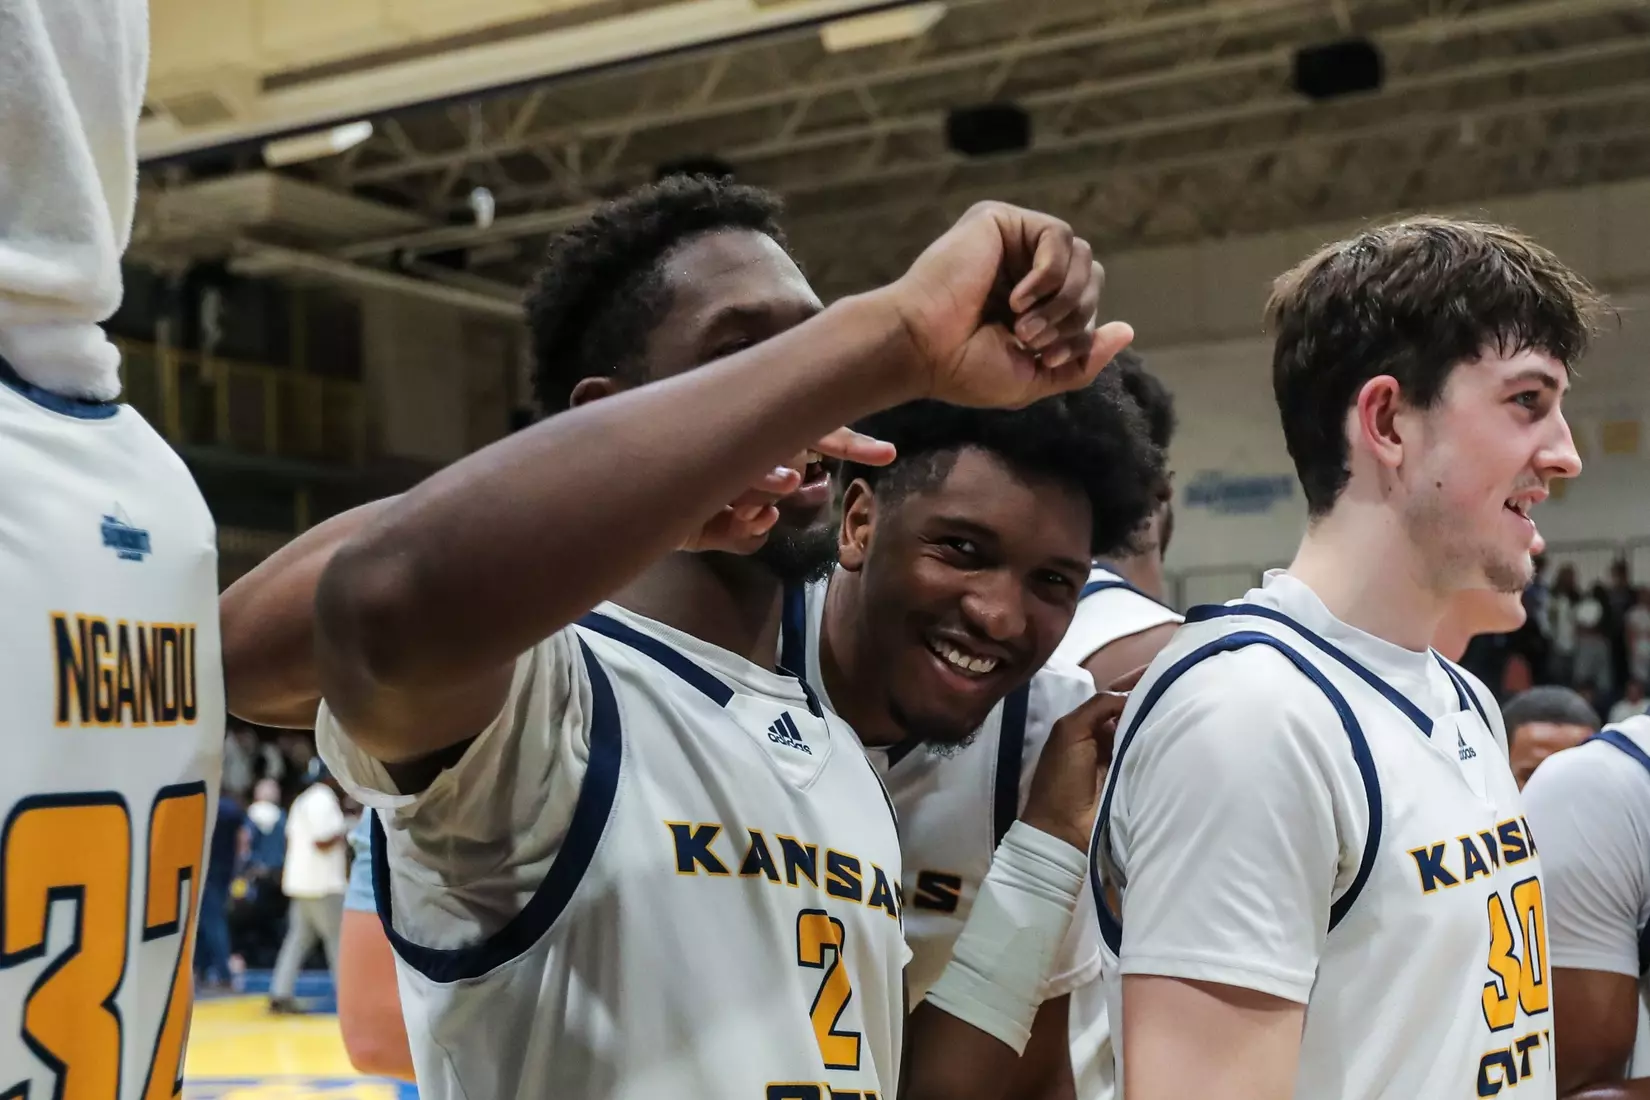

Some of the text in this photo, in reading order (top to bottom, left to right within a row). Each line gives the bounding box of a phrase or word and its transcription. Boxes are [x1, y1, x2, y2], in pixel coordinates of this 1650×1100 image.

[51, 611, 198, 728] NGANDU
[767, 732, 813, 756] adidas
[664, 820, 904, 921] KANSA
[0, 780, 207, 1100] 32
[796, 908, 862, 1071] 2
[1476, 1029, 1551, 1100] CIT
